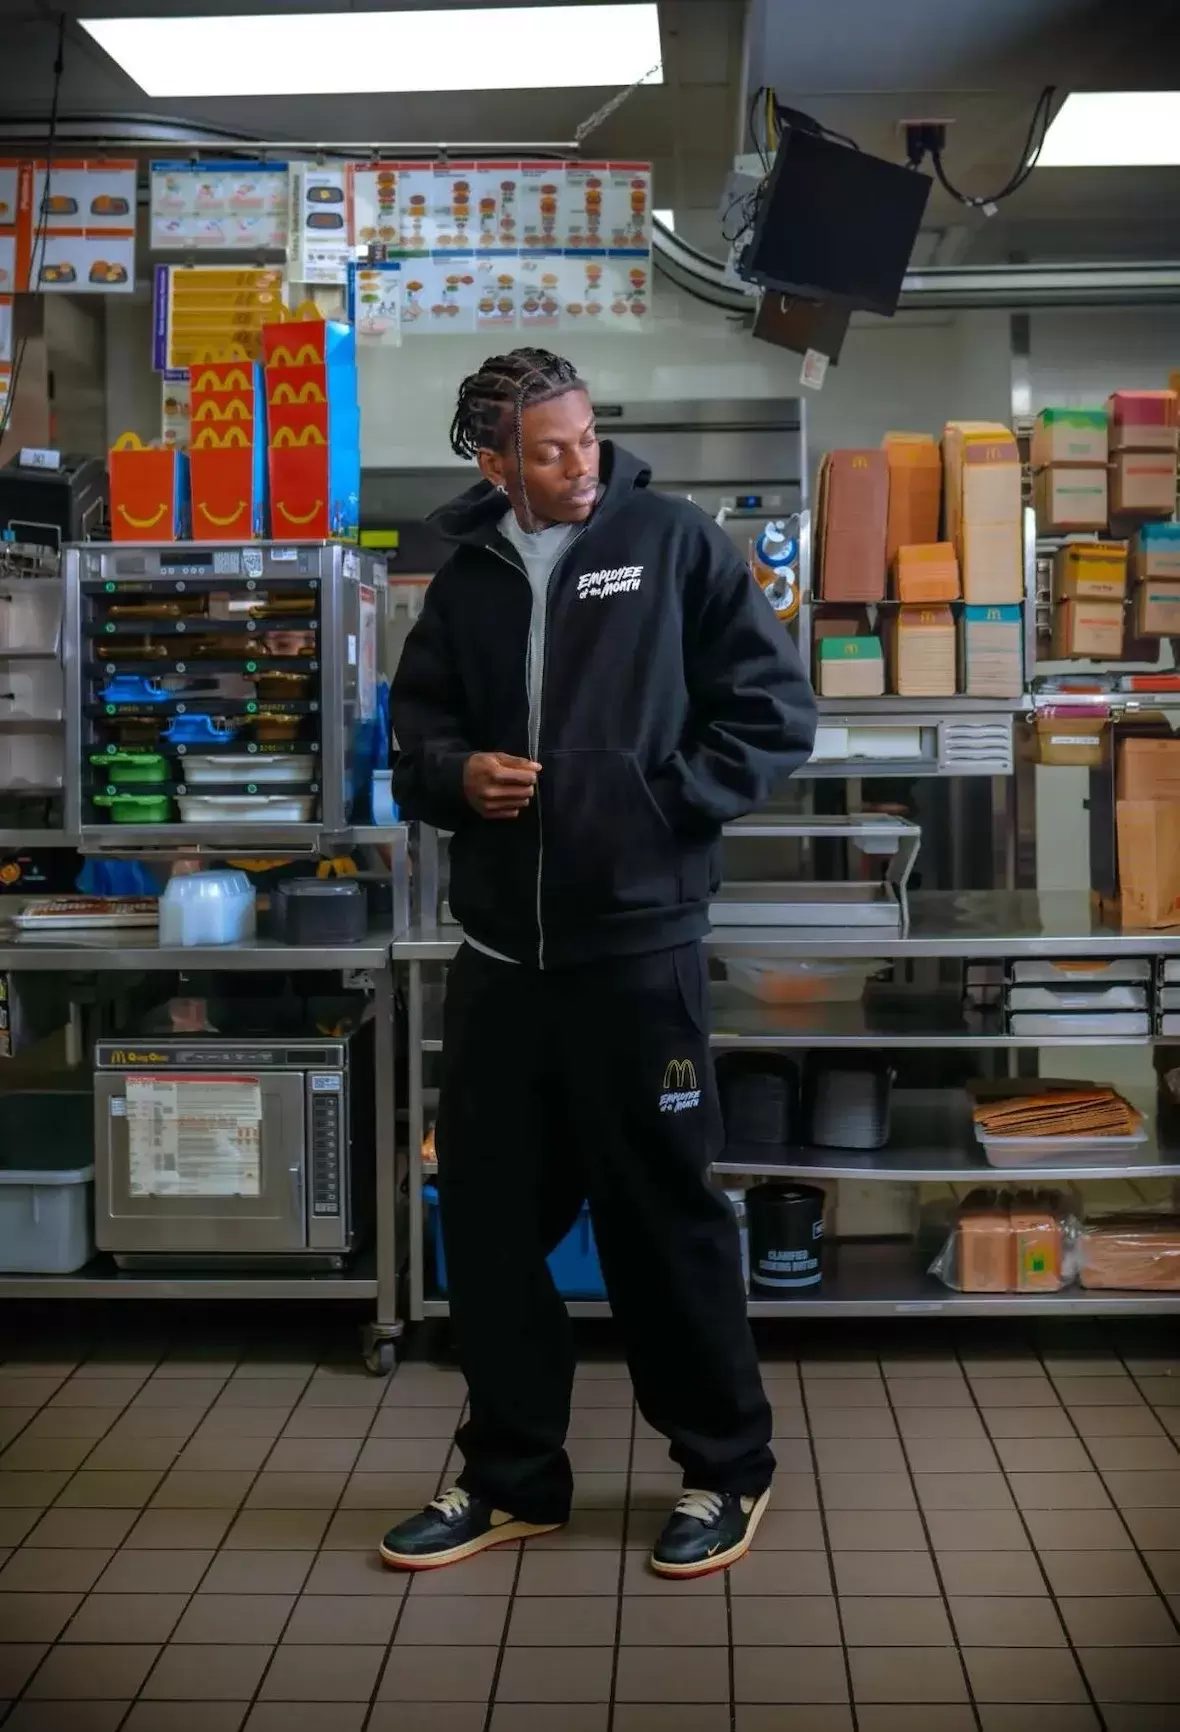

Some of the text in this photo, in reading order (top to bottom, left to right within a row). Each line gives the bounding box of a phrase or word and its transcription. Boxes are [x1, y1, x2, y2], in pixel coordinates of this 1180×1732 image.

[577, 566, 644, 590] EMPLOYEE
[579, 579, 641, 599] of the MONTH
